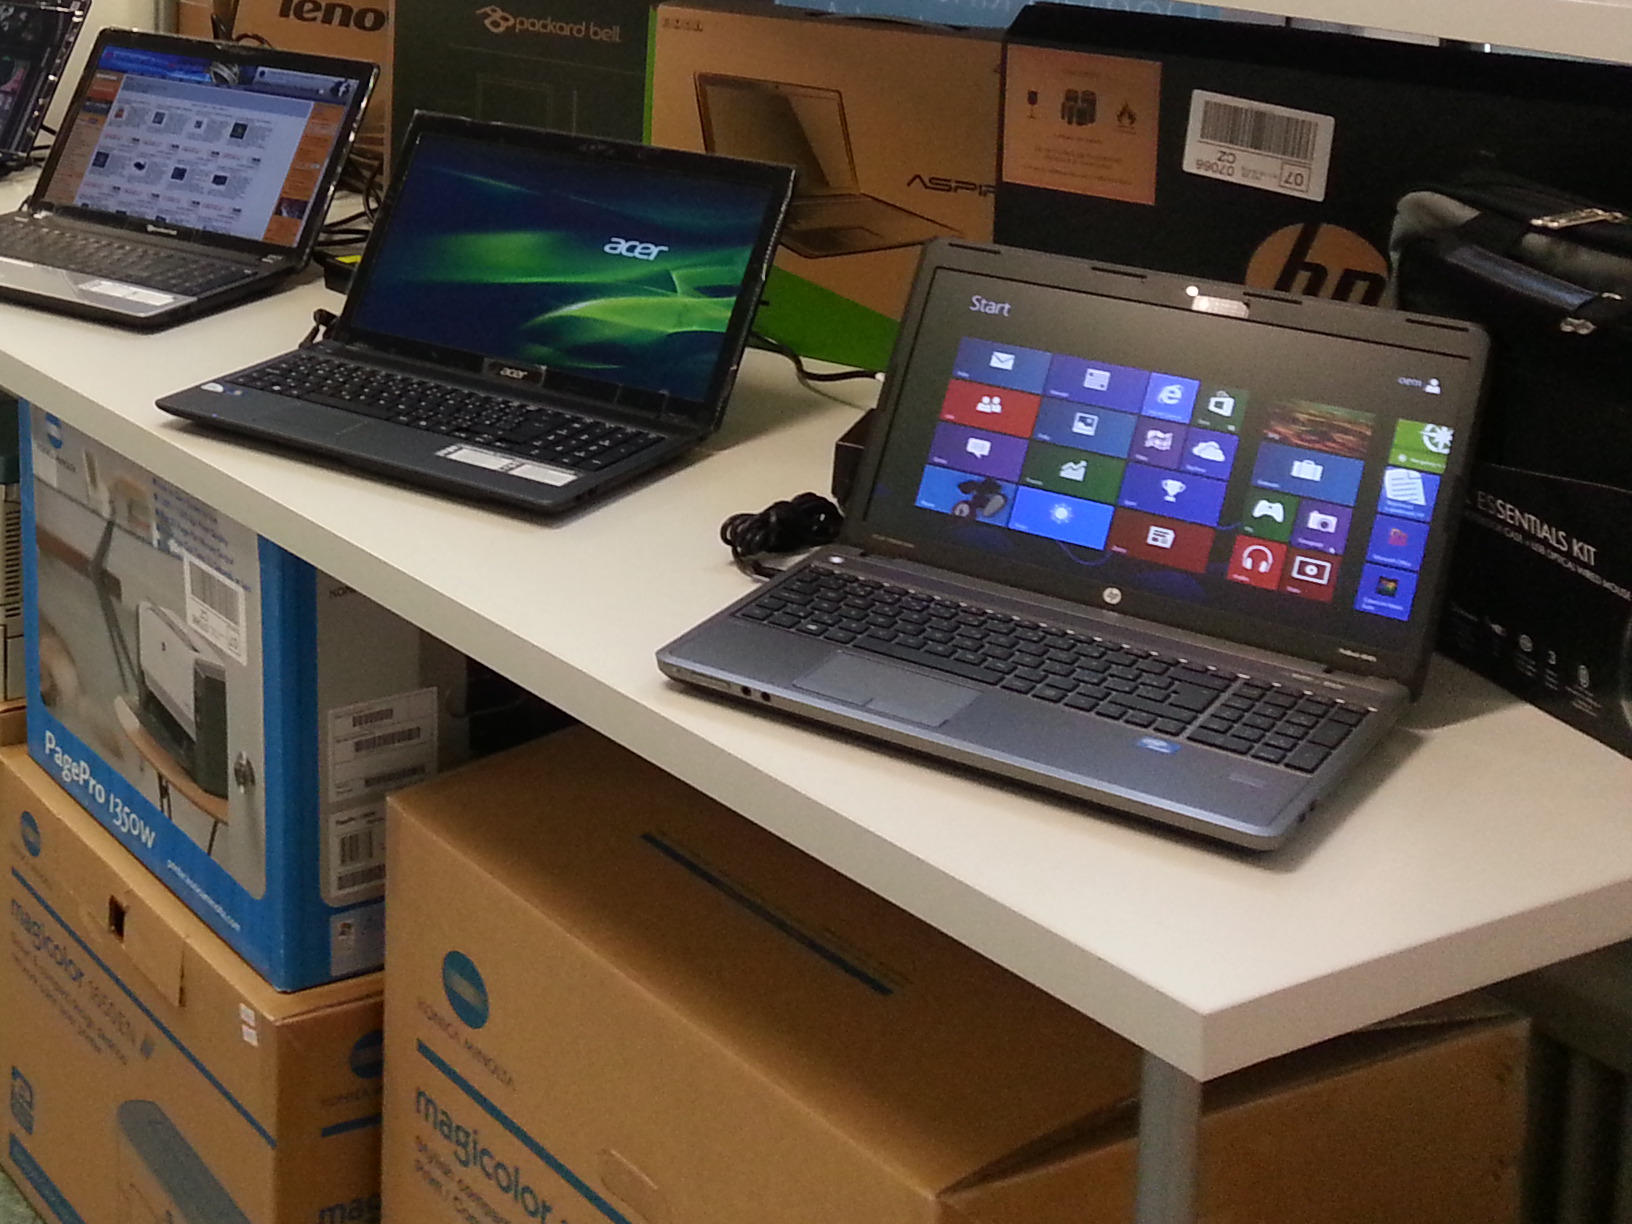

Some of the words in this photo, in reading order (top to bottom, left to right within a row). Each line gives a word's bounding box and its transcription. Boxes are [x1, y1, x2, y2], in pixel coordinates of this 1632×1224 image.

[515, 16, 587, 39] packard
[589, 21, 622, 44] bell
[604, 237, 669, 261] acer
[969, 295, 1012, 318] Start
[499, 366, 528, 379] acer
[1398, 376, 1423, 387] oem
[1477, 490, 1569, 552] ESSENTIALS
[1572, 537, 1598, 566] KIT
[44, 729, 106, 804] PagePro
[108, 793, 157, 849] 1350W
[416, 1085, 553, 1224] magicolor
